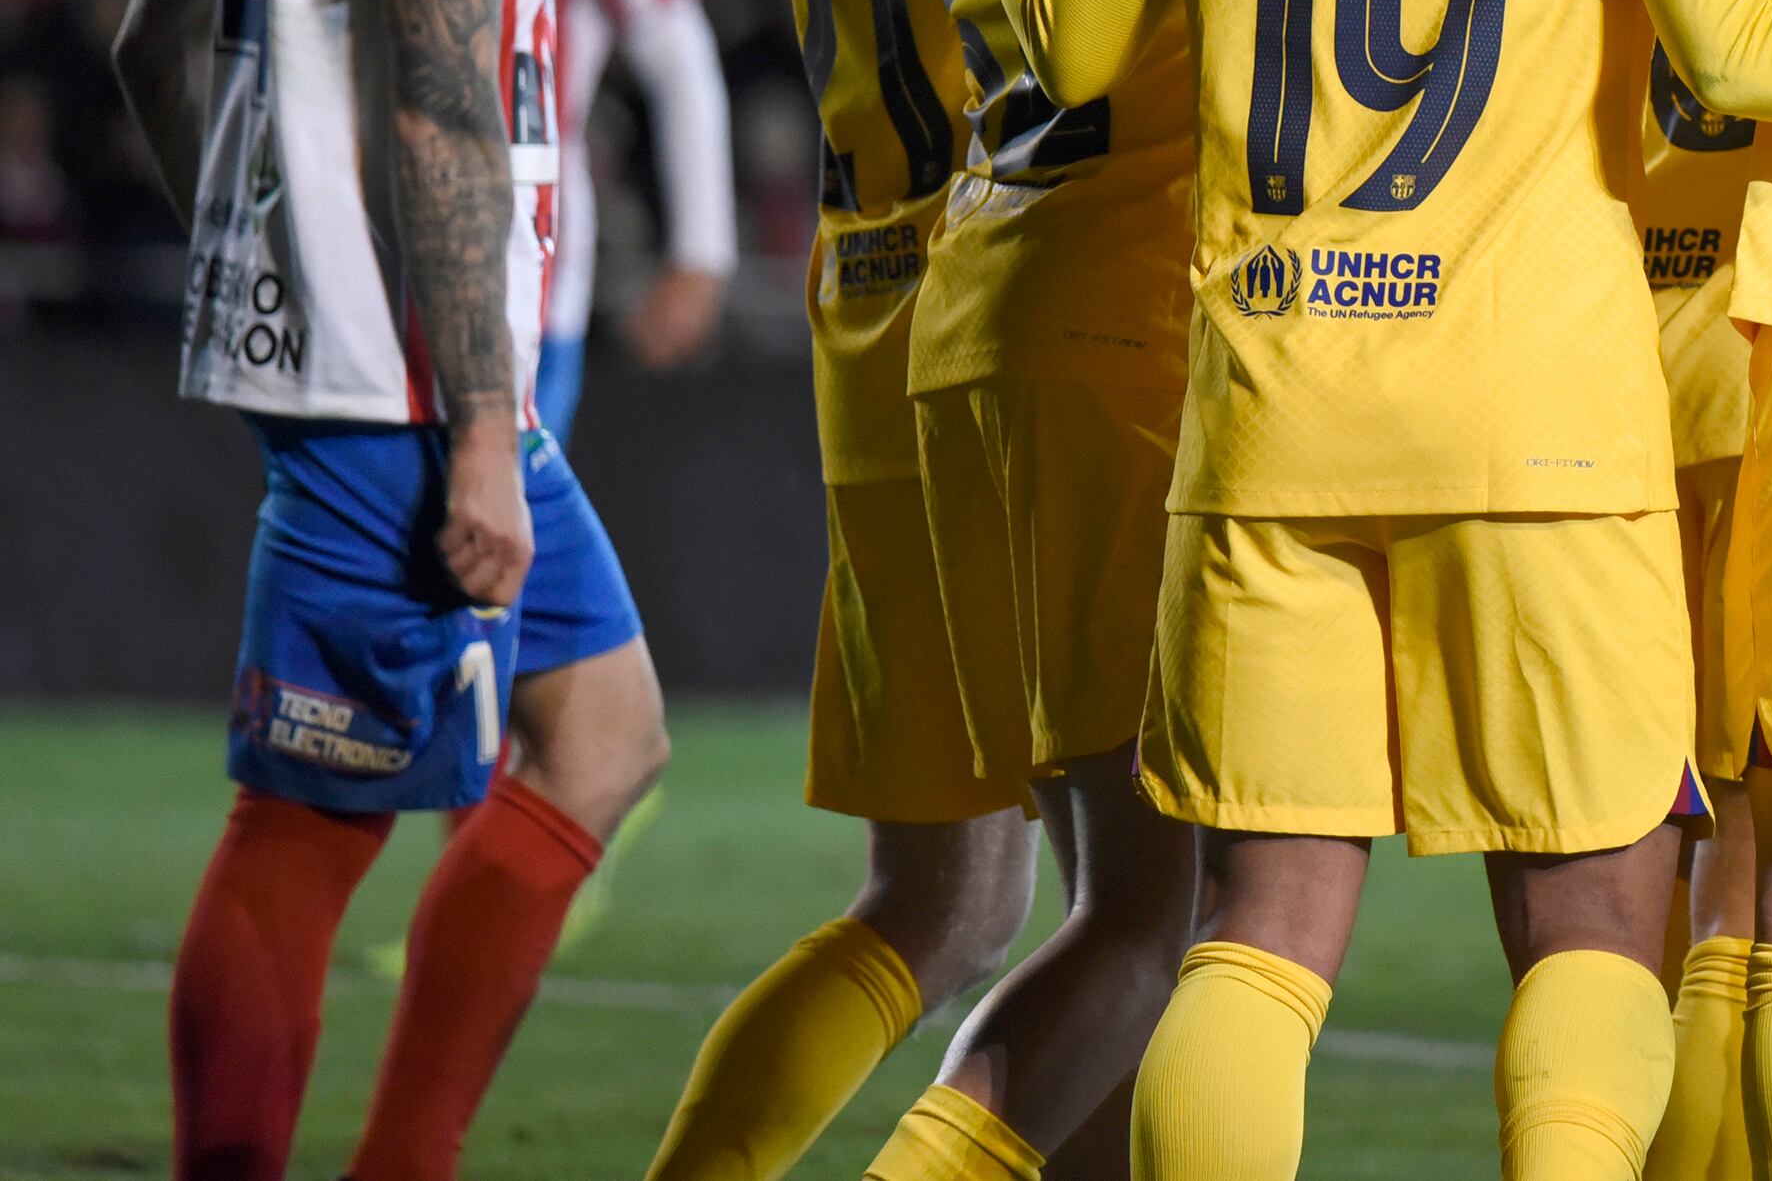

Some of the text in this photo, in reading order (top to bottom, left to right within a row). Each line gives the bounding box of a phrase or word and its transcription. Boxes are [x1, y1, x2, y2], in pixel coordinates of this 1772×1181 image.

[1645, 227, 1721, 252] HCR
[1311, 248, 1442, 280] UNHCR
[1644, 254, 1716, 279] NUR
[1307, 278, 1438, 307] ACNUR
[1307, 306, 1435, 321] The UN Refugee Agency
